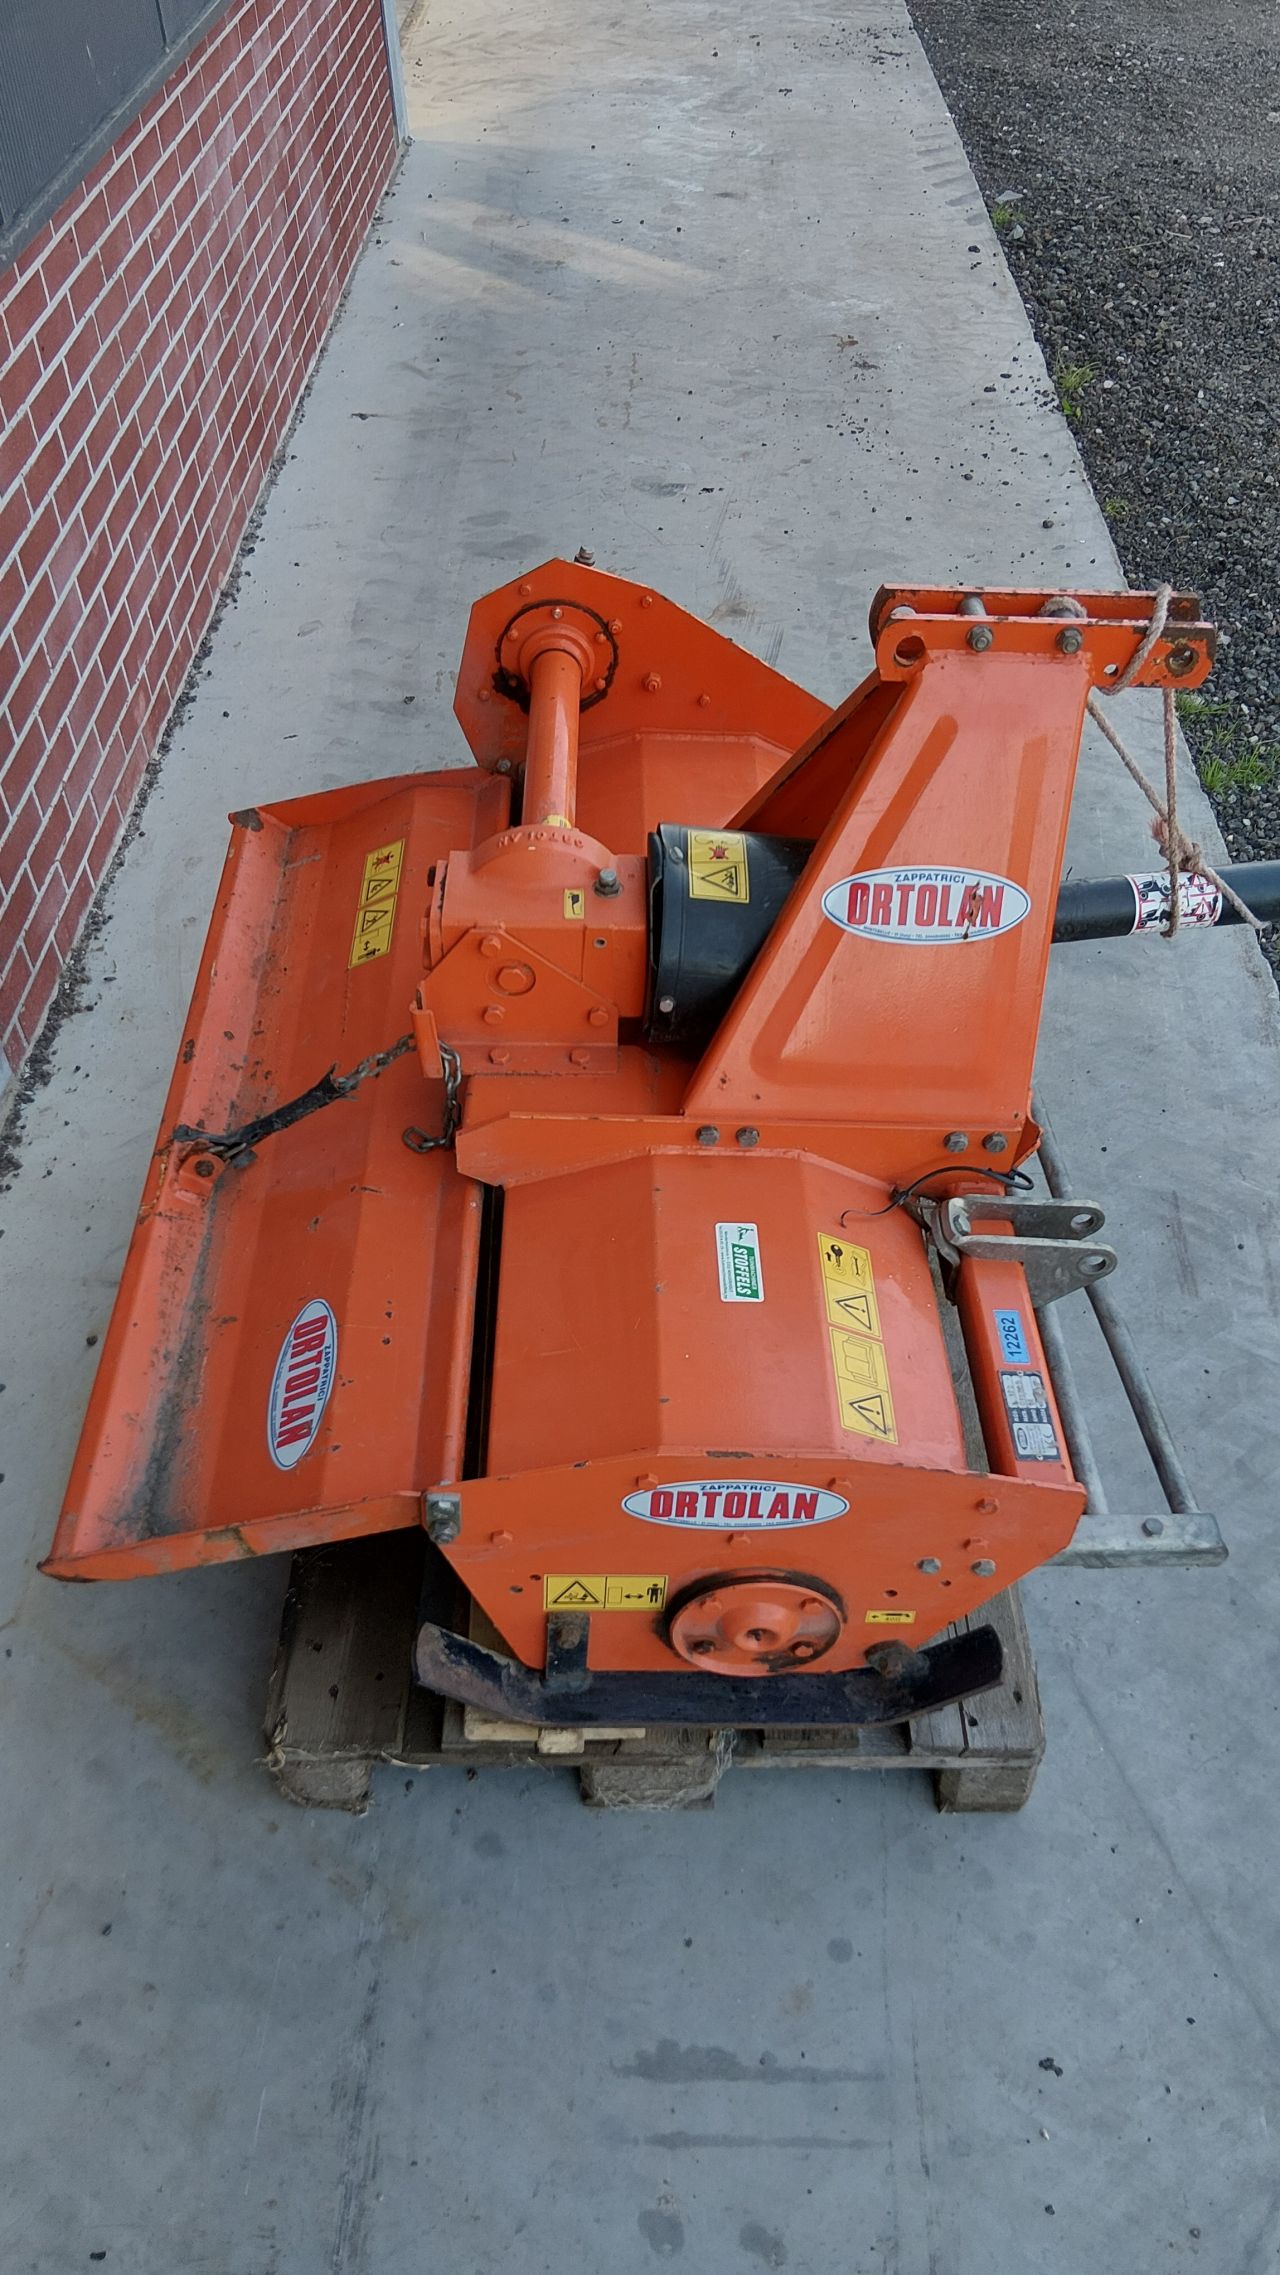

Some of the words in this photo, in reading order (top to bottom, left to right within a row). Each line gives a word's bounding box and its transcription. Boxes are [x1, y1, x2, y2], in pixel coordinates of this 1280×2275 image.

[895, 873, 966, 884] ZAPPATRICI
[847, 882, 1004, 927] ORTOLAN
[733, 1246, 752, 1295] STOFFELS
[1001, 1317, 1022, 1357] 12262
[276, 1314, 328, 1450] ORTOLAN
[317, 1343, 332, 1401] ZAPPATRICI
[649, 1491, 820, 1520] ORTOLAN
[700, 1484, 777, 1492] ZAPPATRICI
